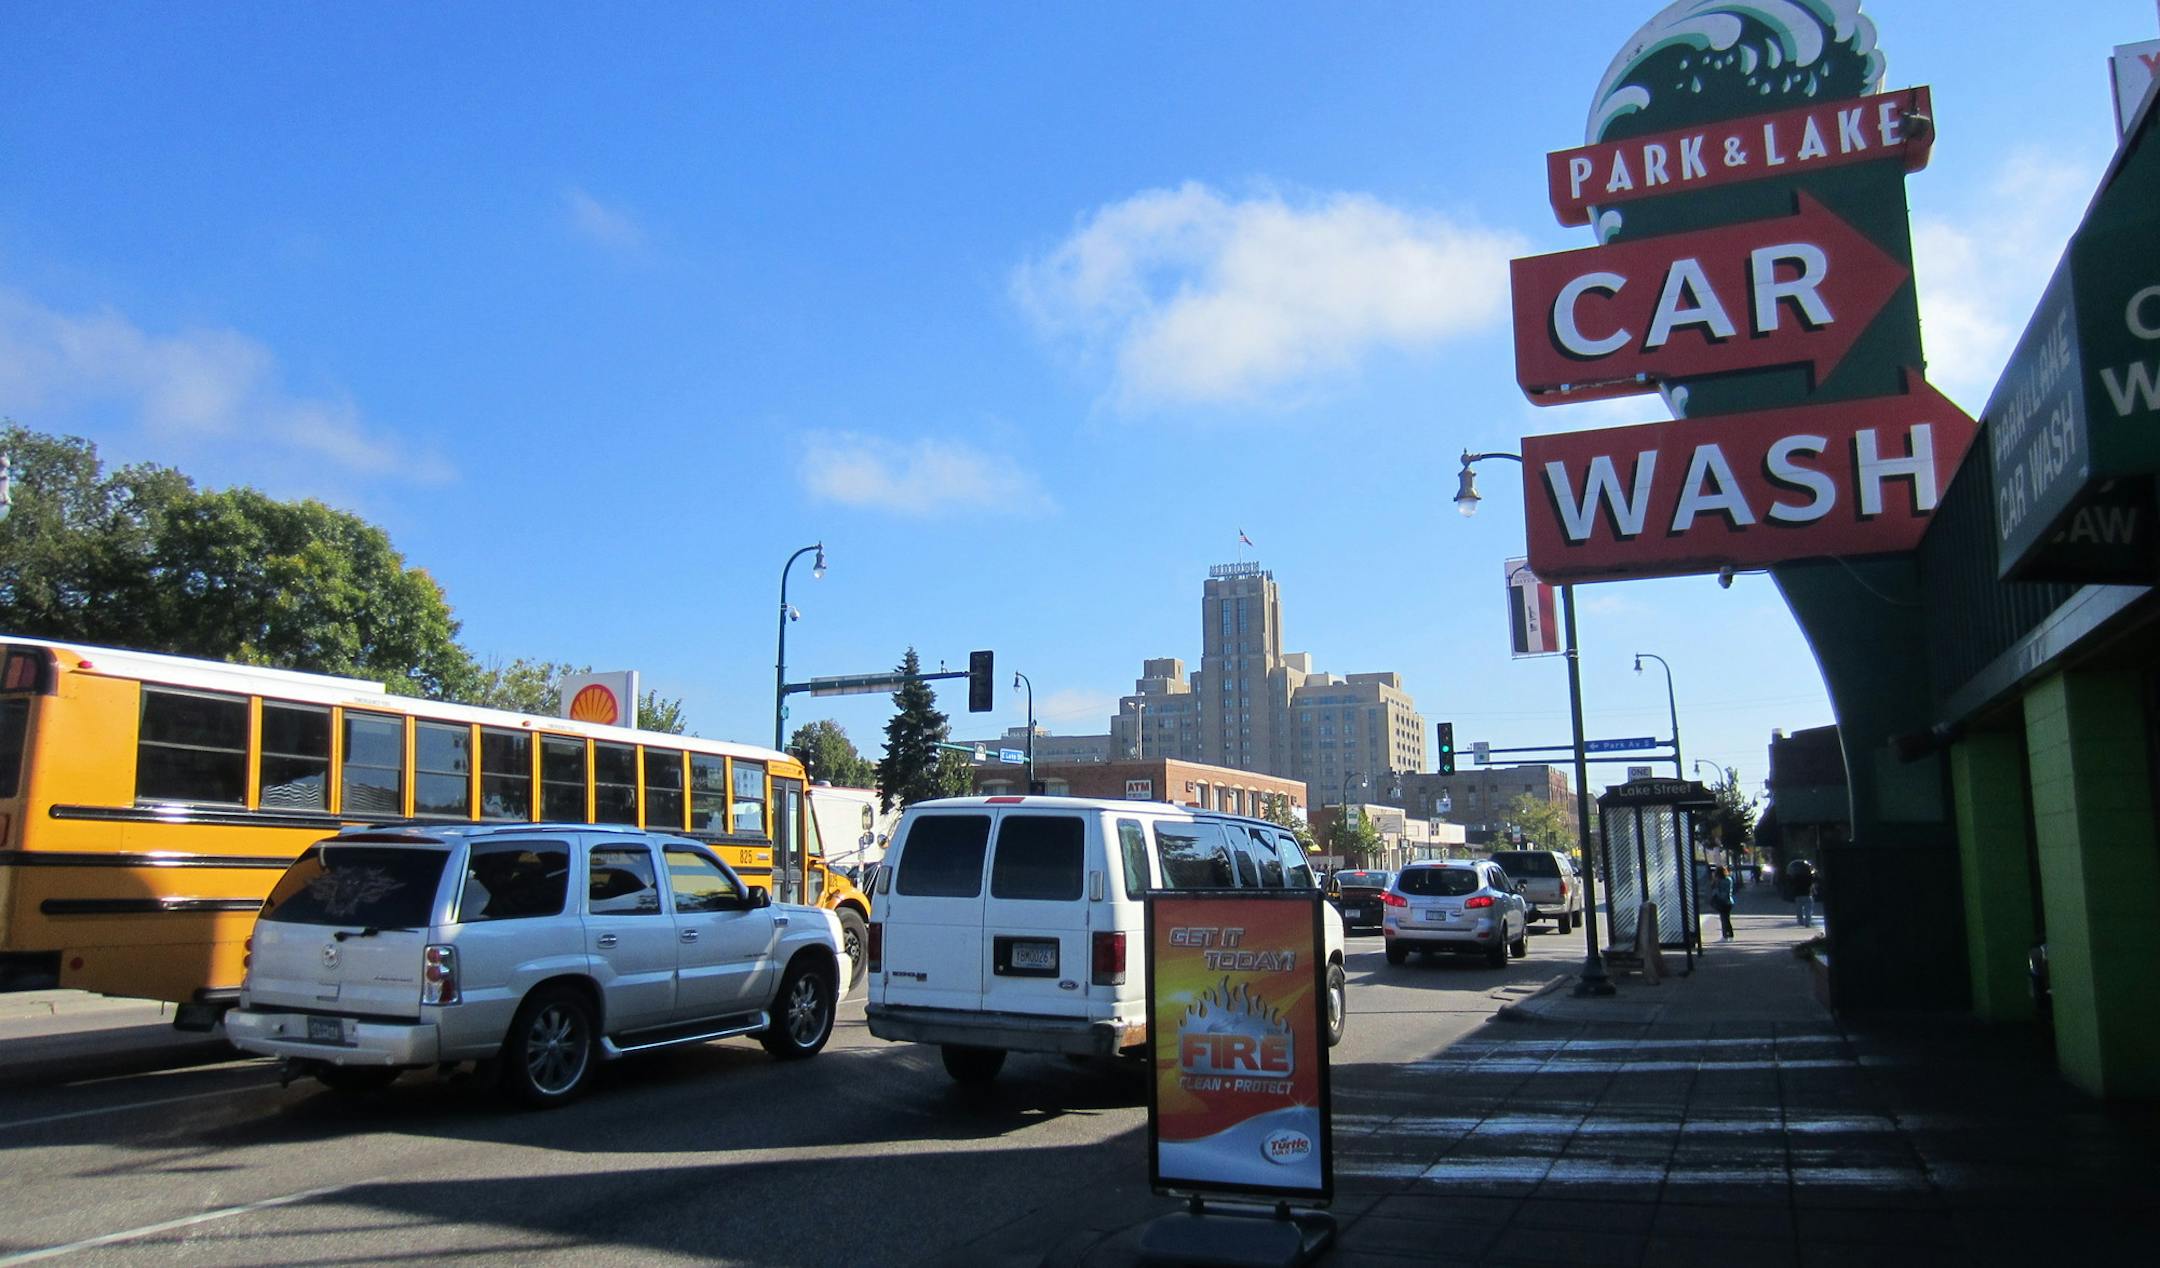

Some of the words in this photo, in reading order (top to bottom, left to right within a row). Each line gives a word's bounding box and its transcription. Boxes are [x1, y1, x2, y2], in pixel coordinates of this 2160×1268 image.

[1569, 136, 1707, 200] PARK
[1723, 136, 1747, 167] &
[1764, 102, 1902, 166] LAKE
[1552, 243, 1834, 357] CAR
[1999, 464, 2027, 541] CAR
[2029, 390, 2076, 501] WASH
[1544, 423, 1937, 541] WASH
[1603, 741, 1625, 750] Park
[1628, 740, 1641, 749] Av
[1644, 739, 1650, 747] S
[1631, 768, 1649, 777] ONE
[1128, 782, 1149, 792] ATM
[1619, 784, 1650, 797] Lake
[1654, 783, 1692, 795] Street
[740, 849, 753, 864] 825
[1169, 927, 1219, 947] GET
[1220, 927, 1244, 948] IT
[1203, 950, 1297, 971] TODAY!
[1182, 1033, 1289, 1072] FIRE
[1179, 1076, 1221, 1091] CLEAN
[1234, 1079, 1294, 1095] PROTECT
[1271, 1138, 1309, 1150] Turtle
